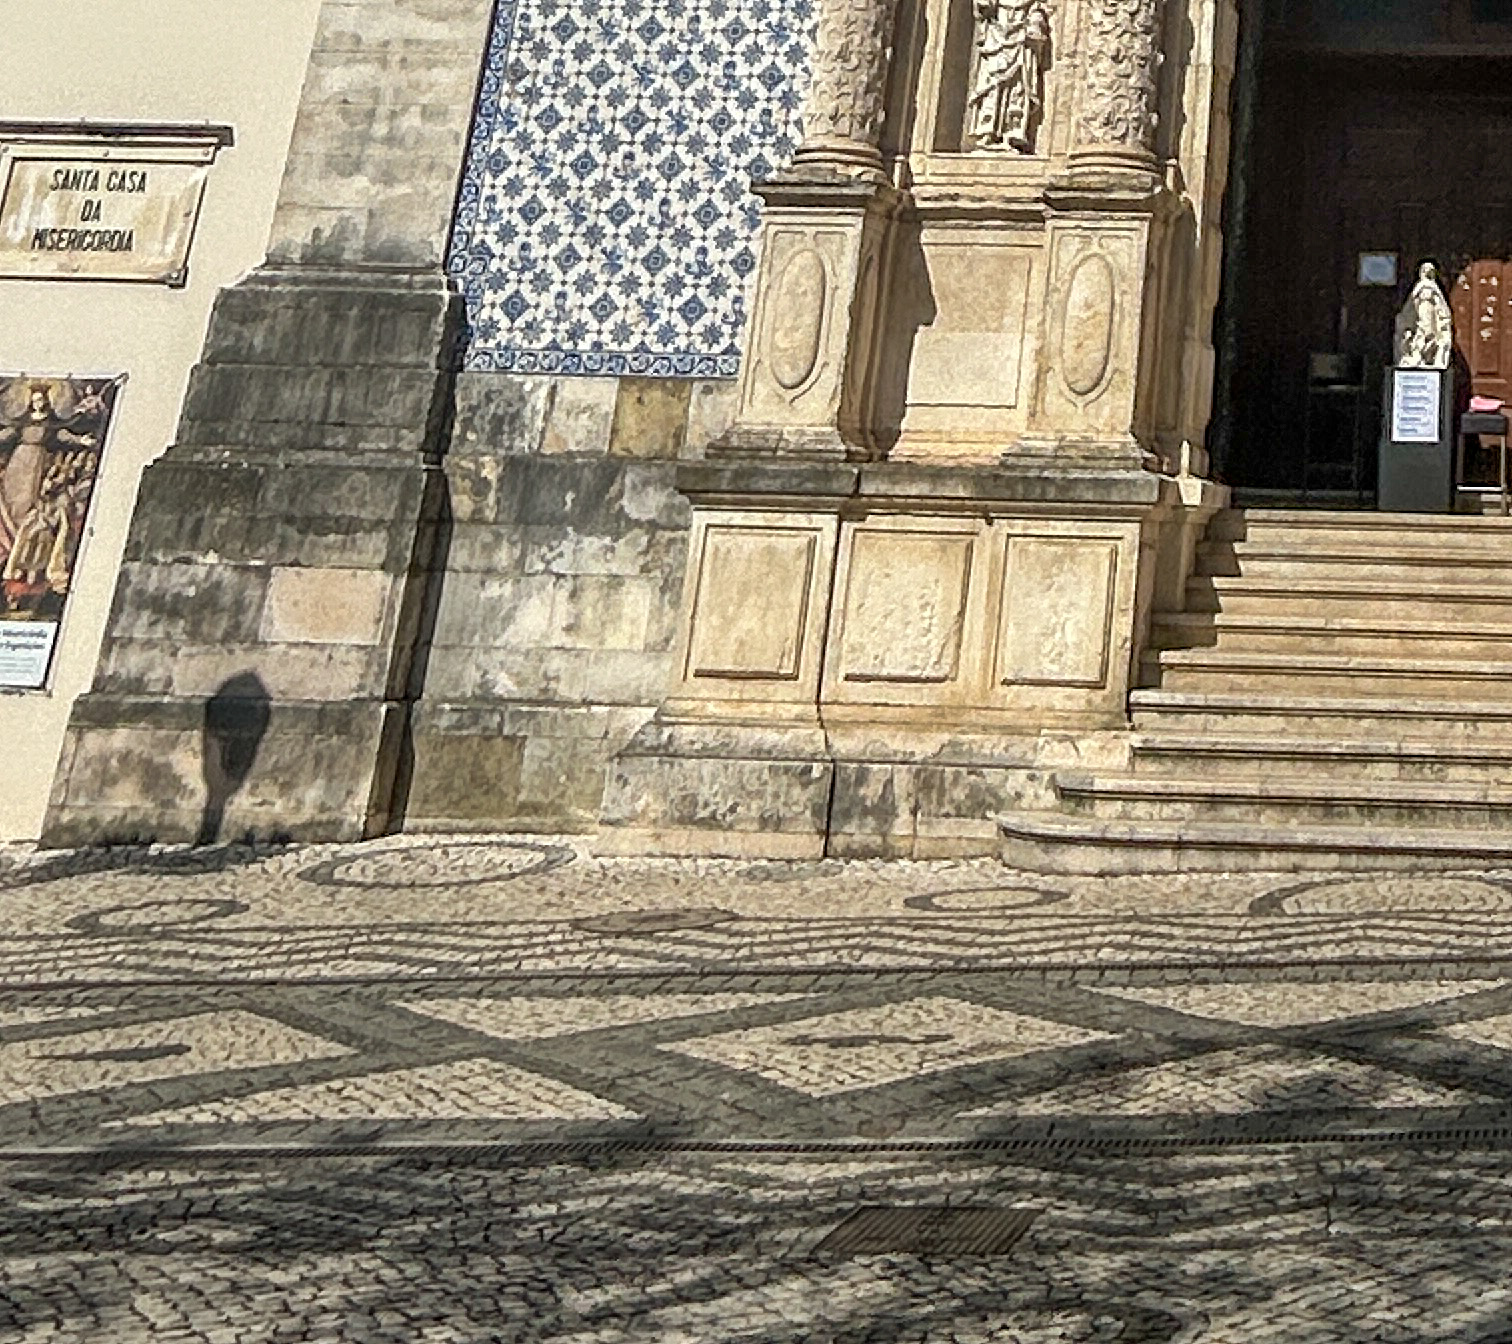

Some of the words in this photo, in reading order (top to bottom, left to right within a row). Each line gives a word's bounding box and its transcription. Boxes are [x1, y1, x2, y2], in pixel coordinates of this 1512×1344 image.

[50, 168, 100, 192] SANTA
[106, 170, 147, 193] CASA
[80, 199, 102, 222] DA
